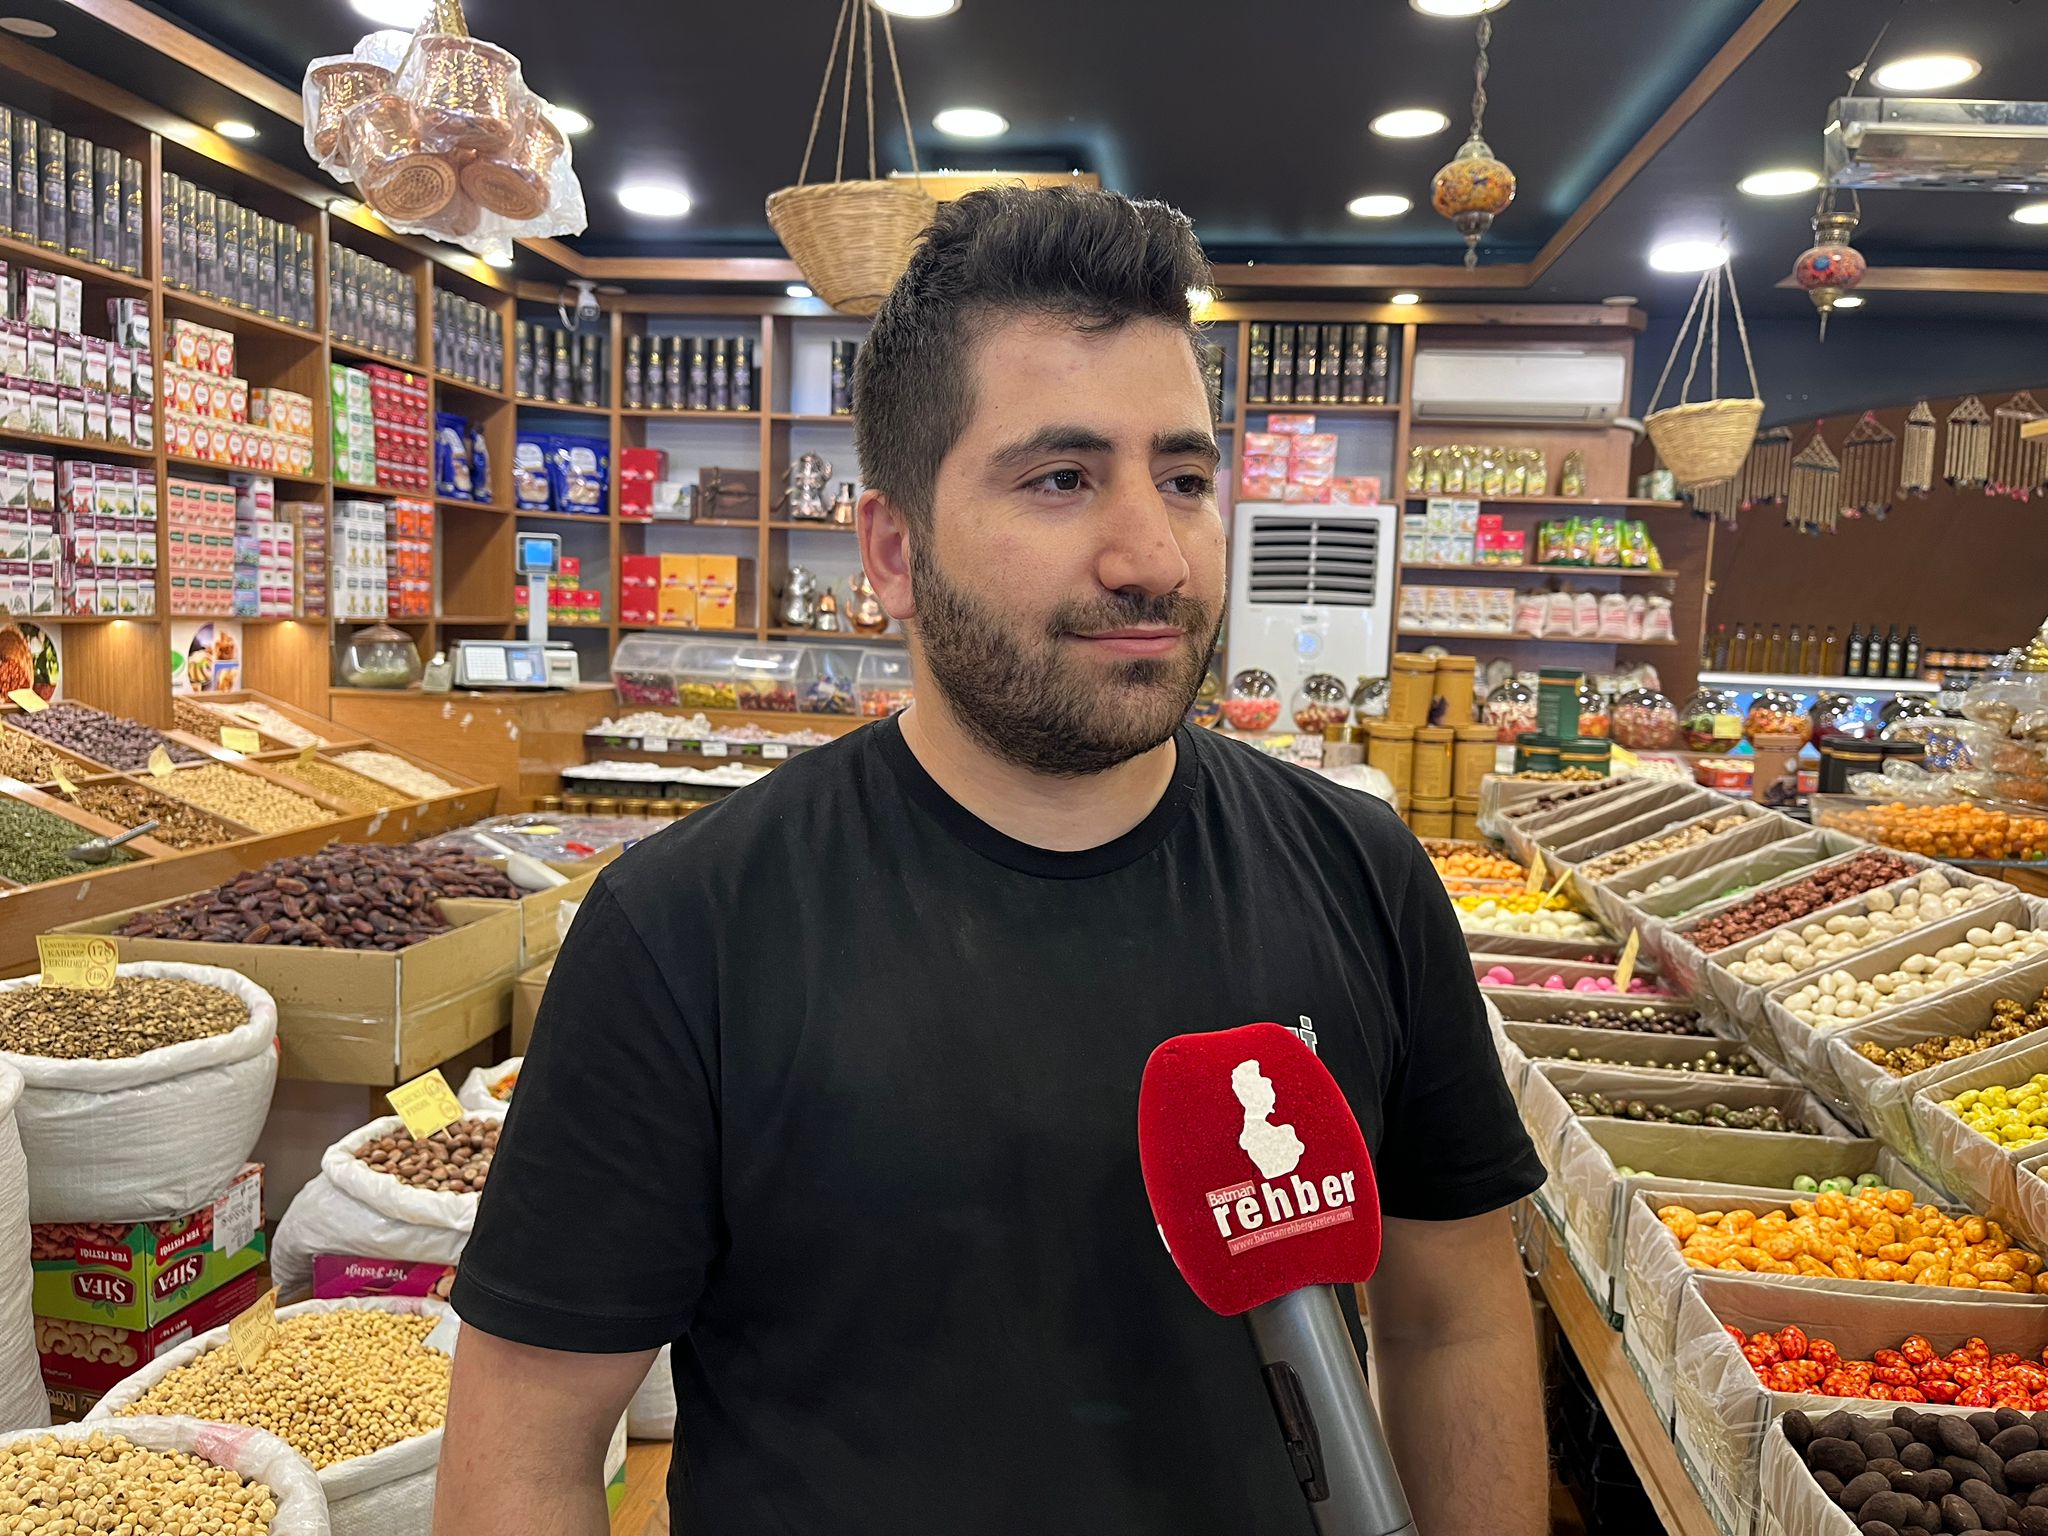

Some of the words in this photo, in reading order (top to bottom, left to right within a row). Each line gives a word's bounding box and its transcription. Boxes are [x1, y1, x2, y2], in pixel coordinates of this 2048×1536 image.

[1208, 1184, 1256, 1207] Batman
[1212, 1170, 1356, 1238] rehber
[110, 1251, 129, 1263] YER
[77, 1275, 127, 1303] ŞİFA
